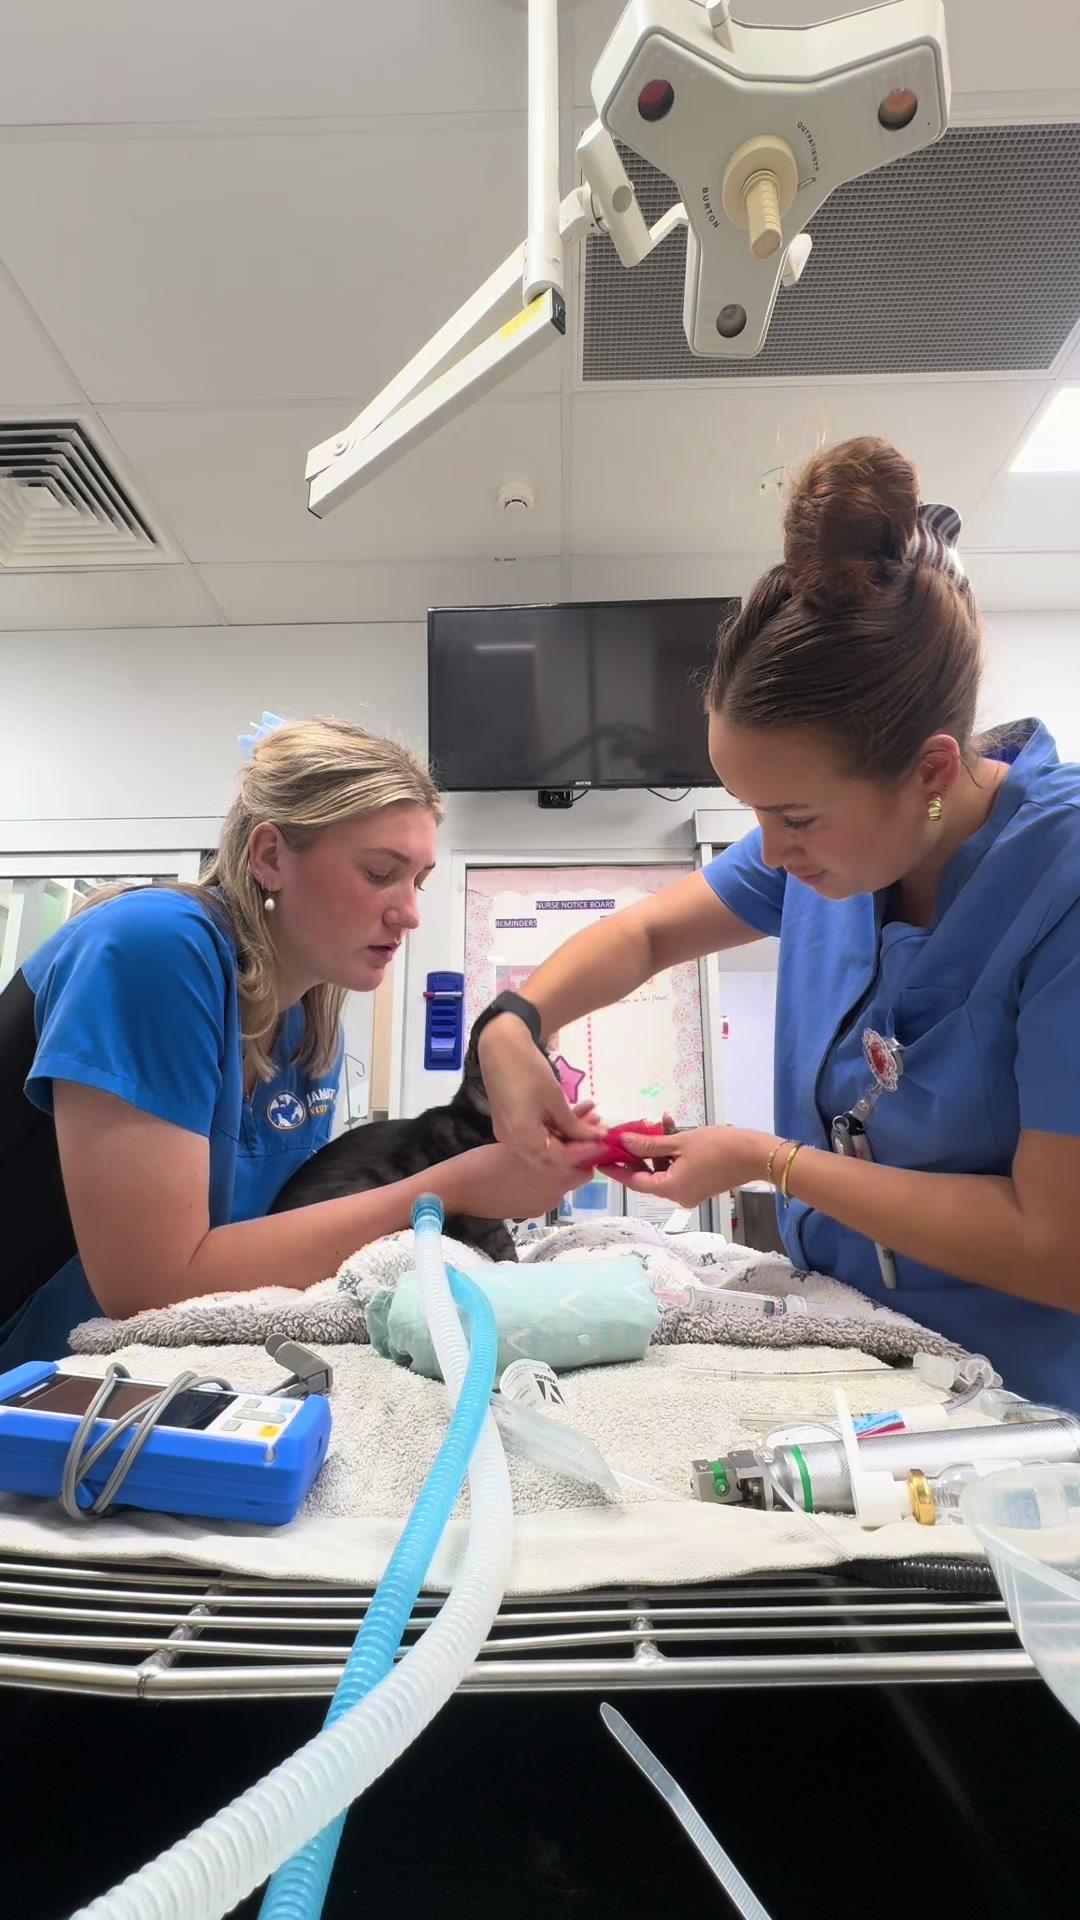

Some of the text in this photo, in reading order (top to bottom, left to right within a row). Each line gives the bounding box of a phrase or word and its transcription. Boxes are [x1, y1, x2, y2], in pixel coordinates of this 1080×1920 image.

[702, 187, 720, 228] BURTON
[536, 900, 615, 909] NURSE NOTICE BOARD
[495, 919, 537, 927] REMINDERS
